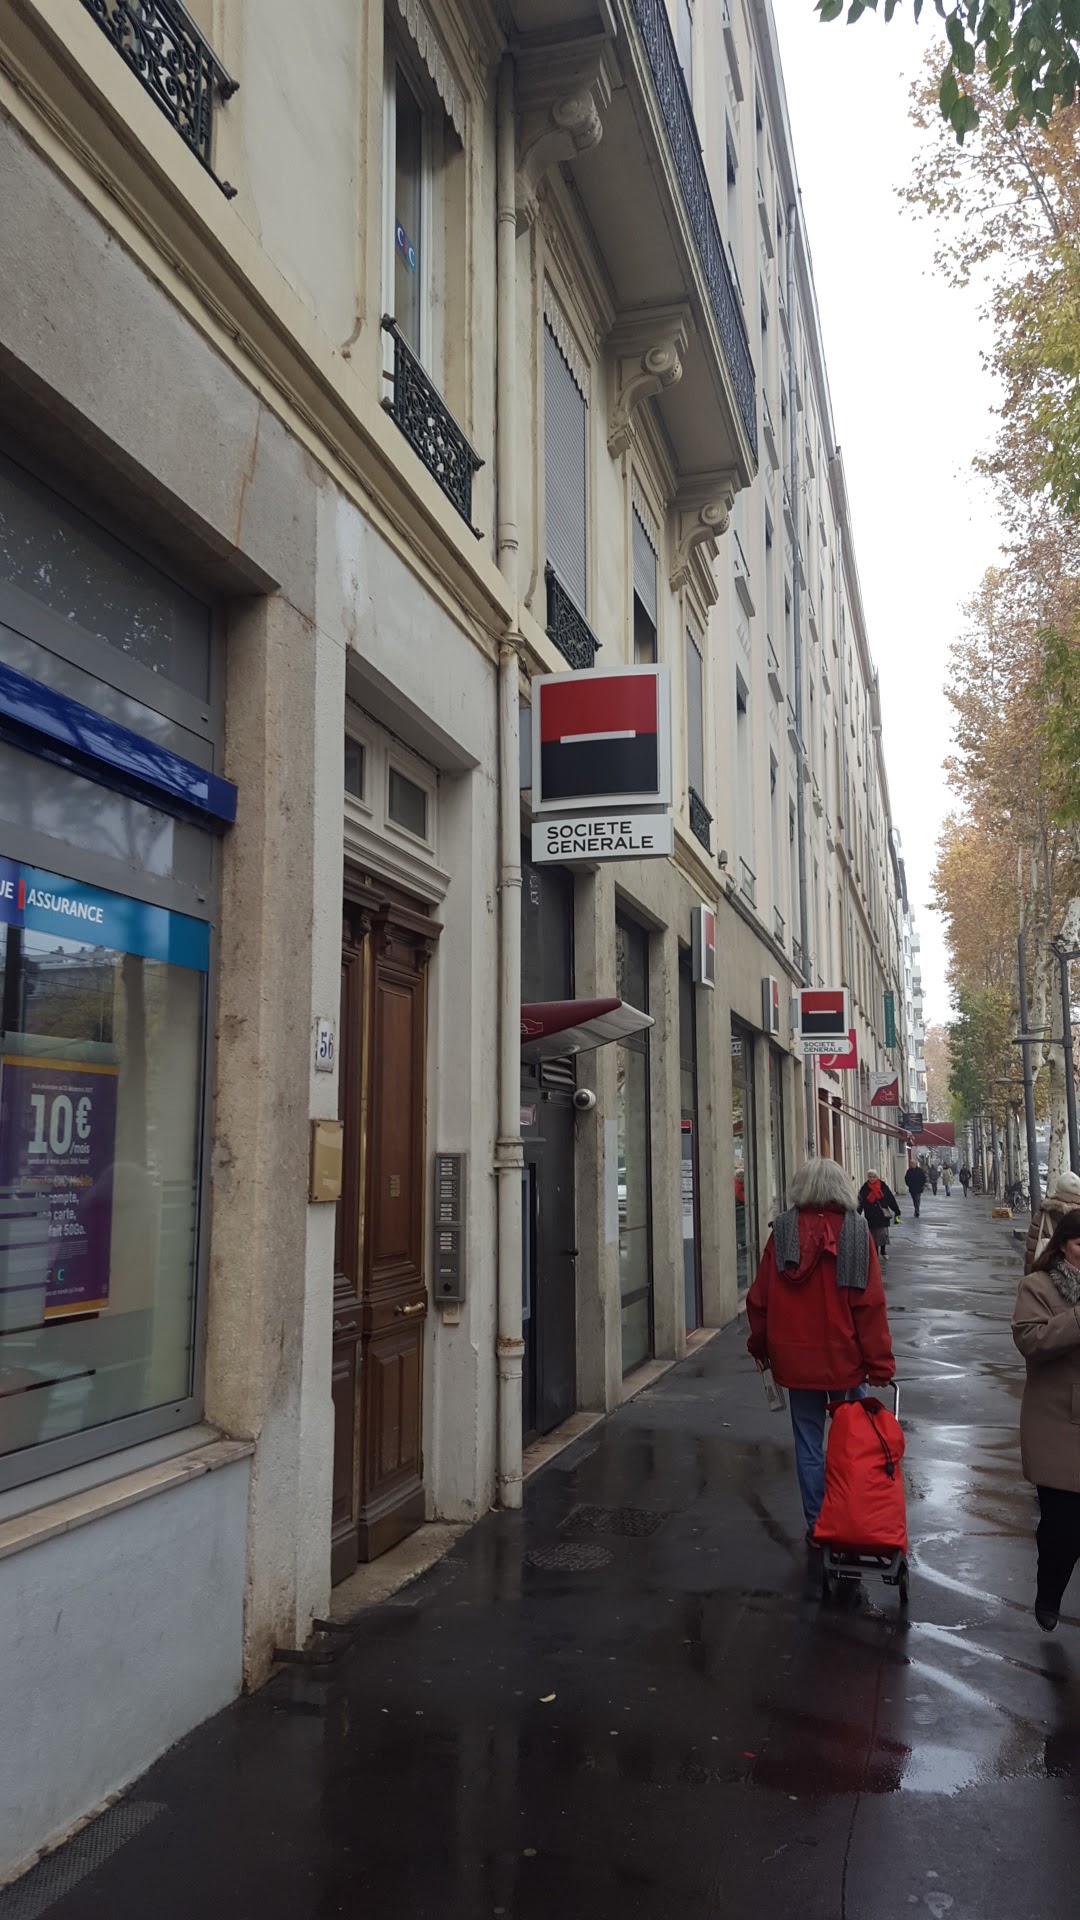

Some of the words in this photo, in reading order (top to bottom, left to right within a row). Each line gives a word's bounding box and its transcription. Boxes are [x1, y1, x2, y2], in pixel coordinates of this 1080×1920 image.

[547, 821, 632, 840] SOCIETE
[547, 835, 654, 855] GENERALE
[27, 888, 104, 924] ASSURANCE
[320, 1031, 334, 1060] 56
[53, 1208, 76, 1221] carte,
